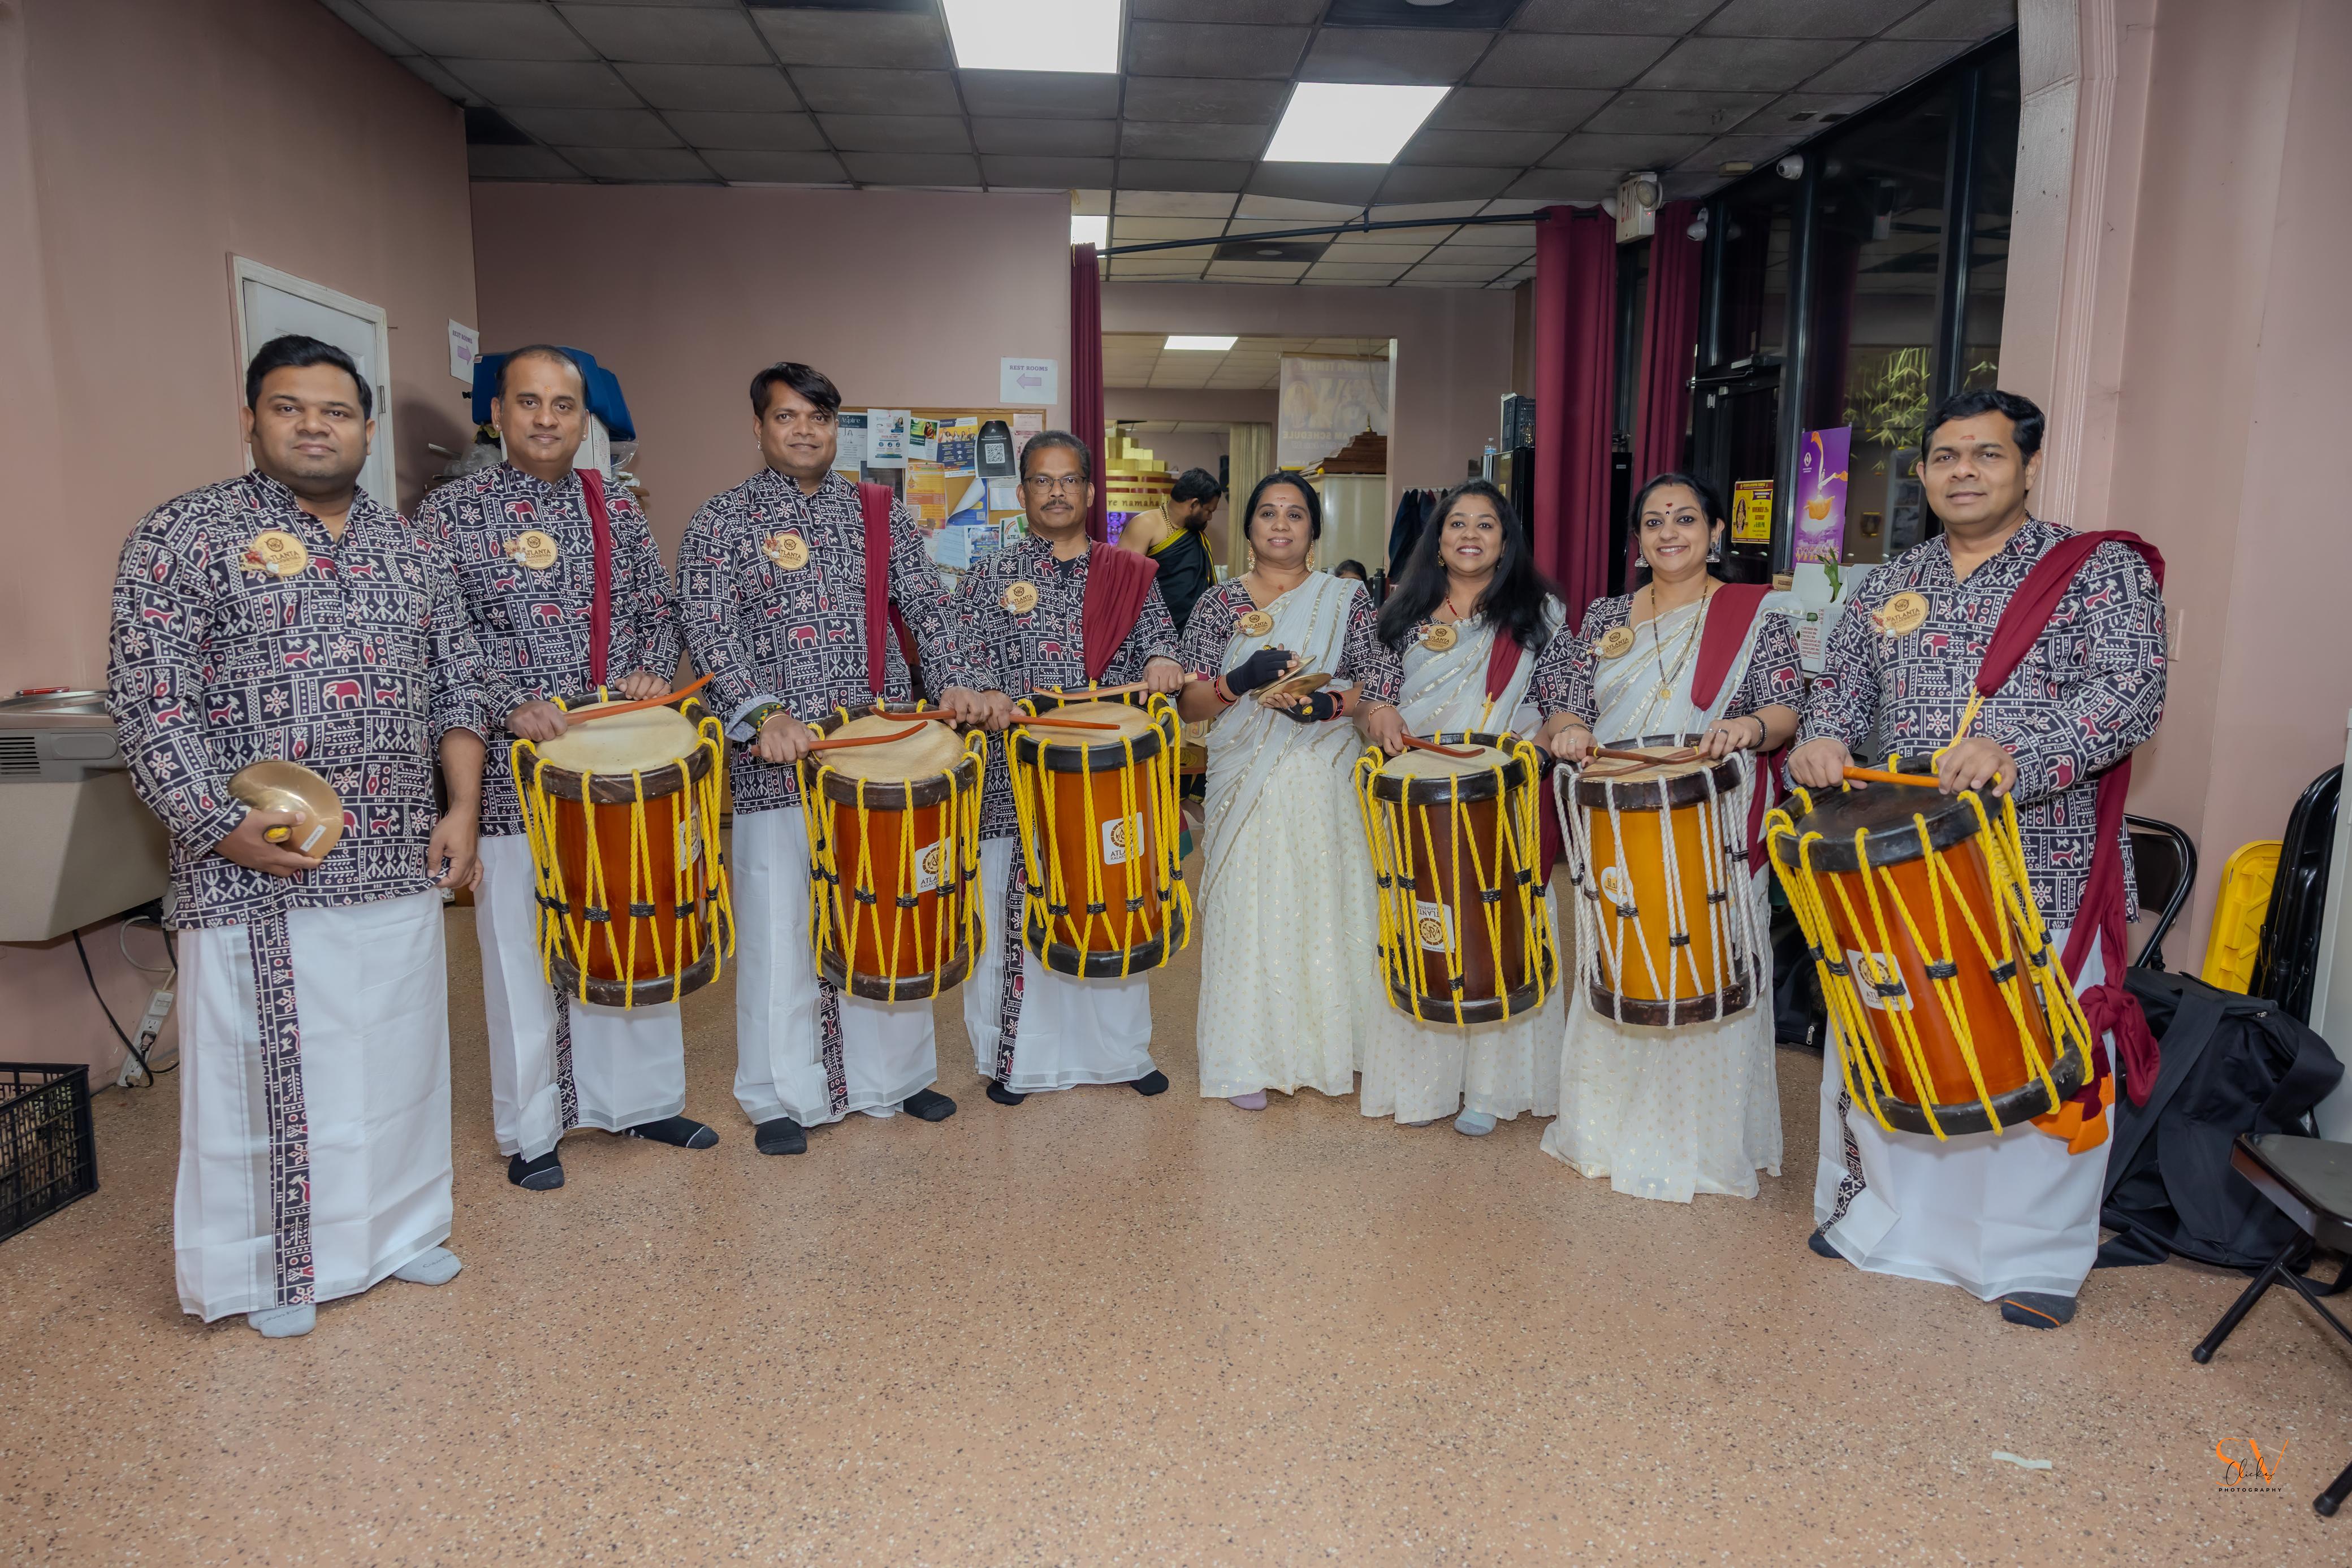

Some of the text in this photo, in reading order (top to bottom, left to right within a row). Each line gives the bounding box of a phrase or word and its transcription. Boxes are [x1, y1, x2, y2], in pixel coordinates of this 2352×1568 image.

[452, 330, 473, 344] REST ROOMS
[1122, 496, 1160, 507] namaha
[270, 550, 300, 561] TLANTA
[1891, 608, 1921, 623] ATLANTA
[1606, 637, 1629, 650] ATLANTA
